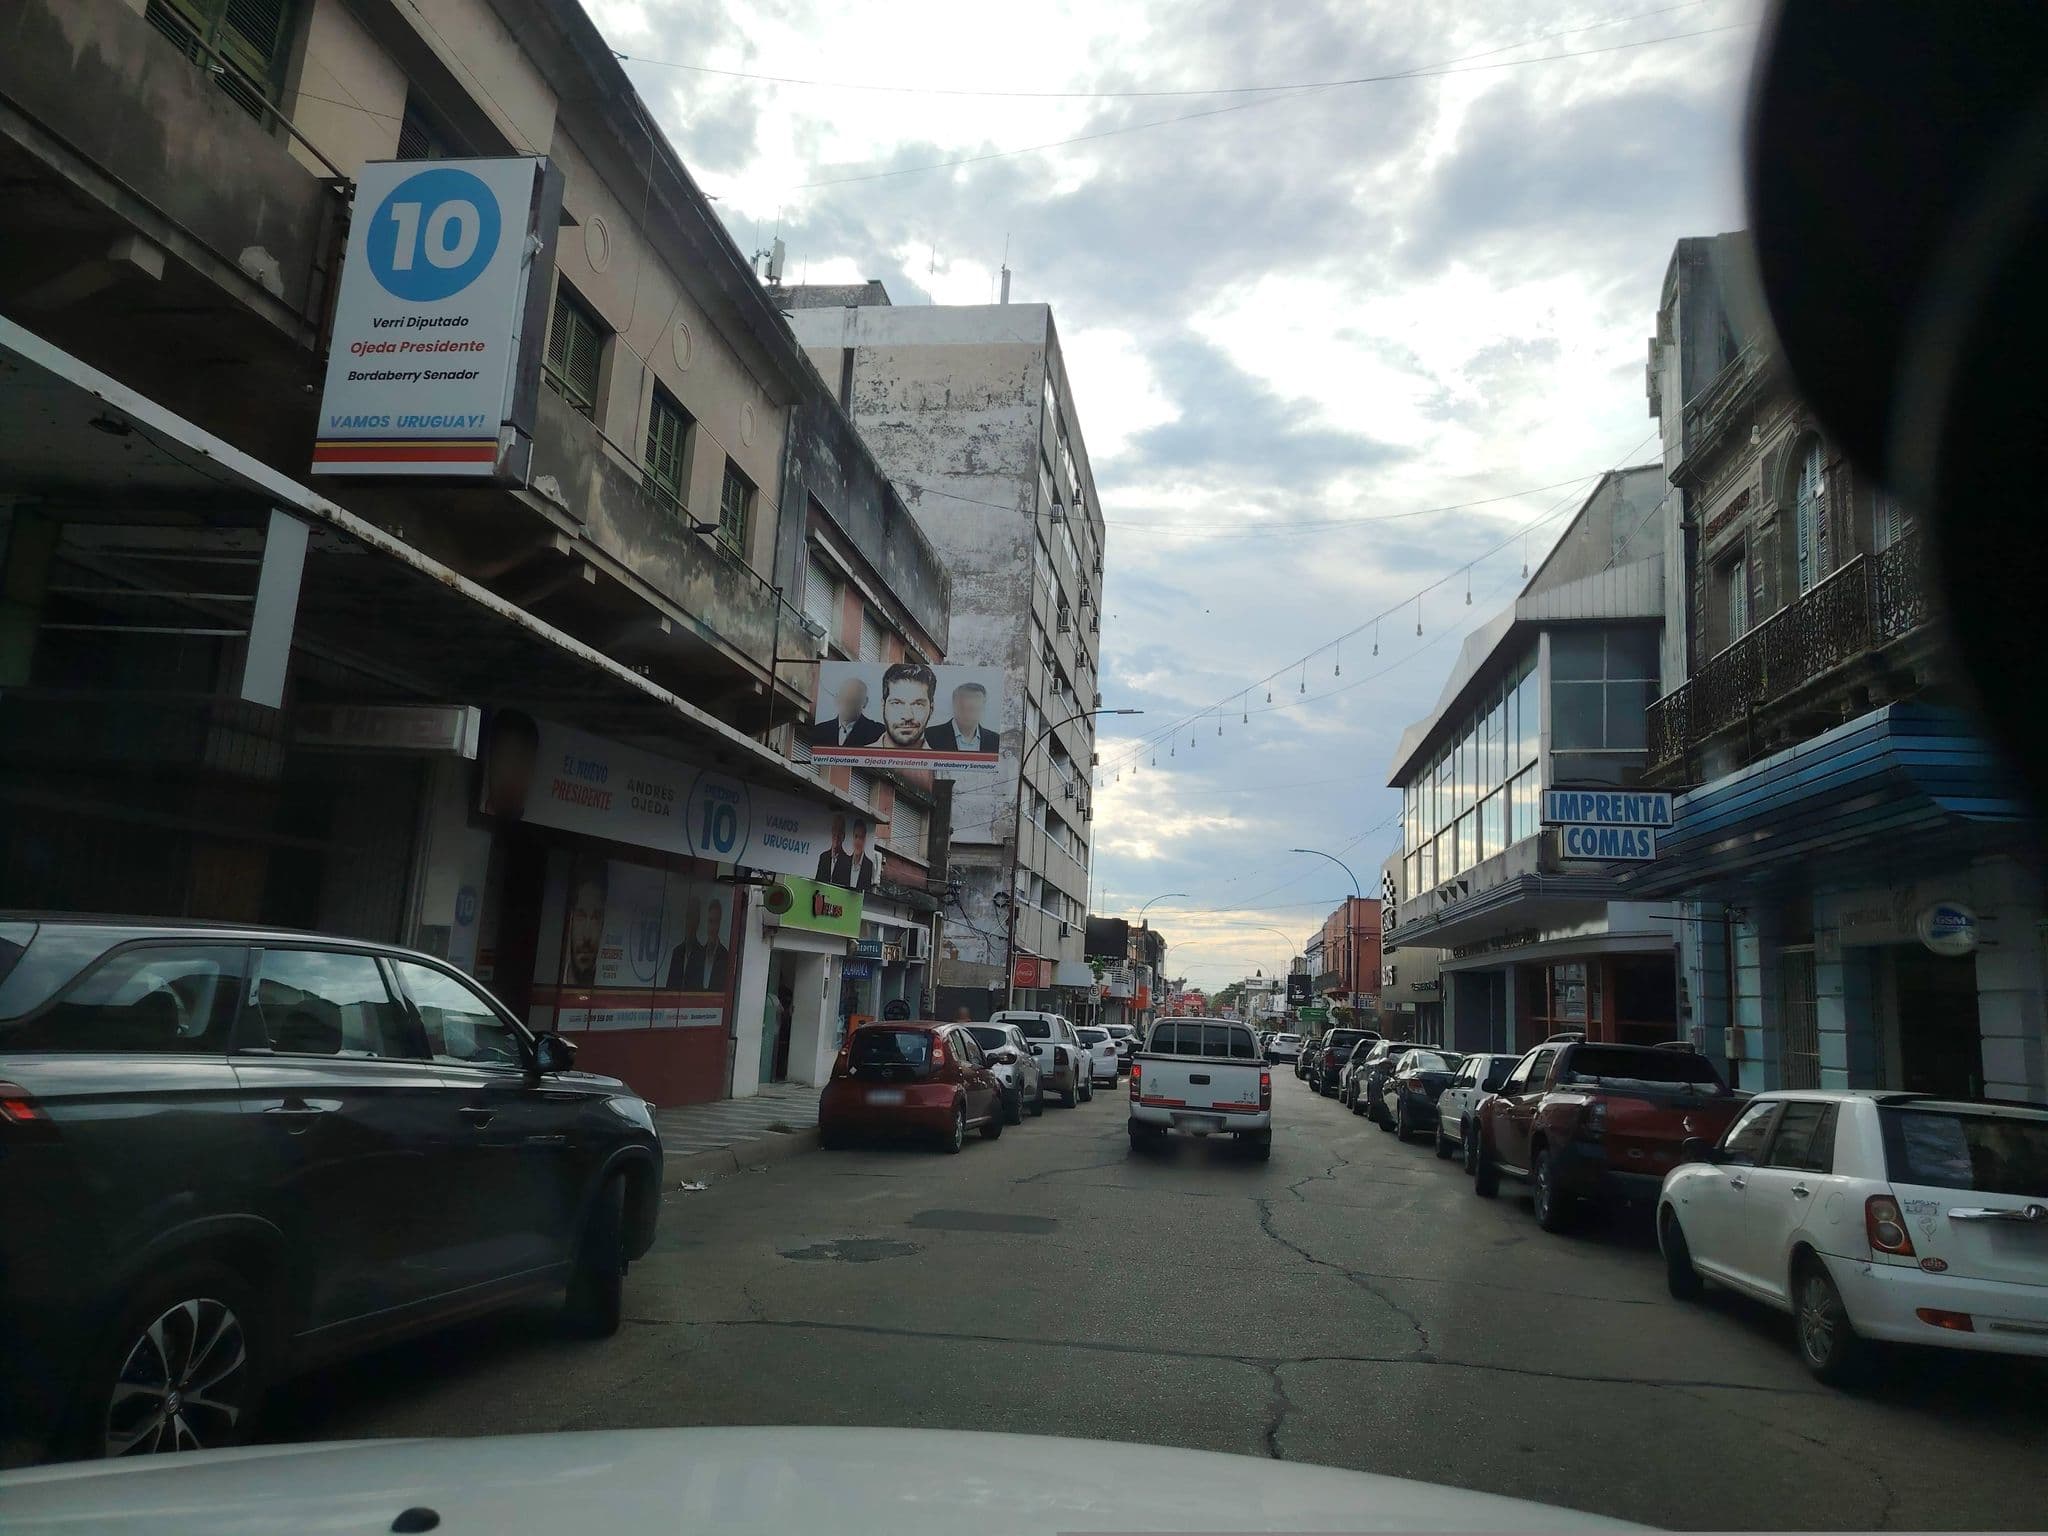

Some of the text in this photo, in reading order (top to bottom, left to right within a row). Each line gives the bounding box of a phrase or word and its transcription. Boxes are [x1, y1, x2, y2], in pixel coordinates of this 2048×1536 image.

[391, 199, 481, 272] 10
[373, 315, 469, 330] Verri Diputado
[350, 340, 485, 357] Ojeda Presidente
[348, 369, 479, 383] Bordaberry Senador
[330, 414, 485, 428] VAMOS URUGUAY!
[829, 757, 859, 765] Diputado
[864, 758, 886, 767] Ojeda
[888, 758, 928, 767] Presidente
[933, 761, 968, 770] Bordaberry
[969, 762, 997, 770] Senador
[552, 777, 613, 811] PRESIDENTE
[631, 796, 671, 816] OJEDA
[1550, 793, 1669, 822] IMPRENTA
[701, 799, 737, 854] 10
[766, 815, 799, 833] VAMOS
[763, 833, 810, 856] URUGUAY!
[1567, 827, 1650, 857] COMAS
[1934, 915, 1967, 926] GSM
